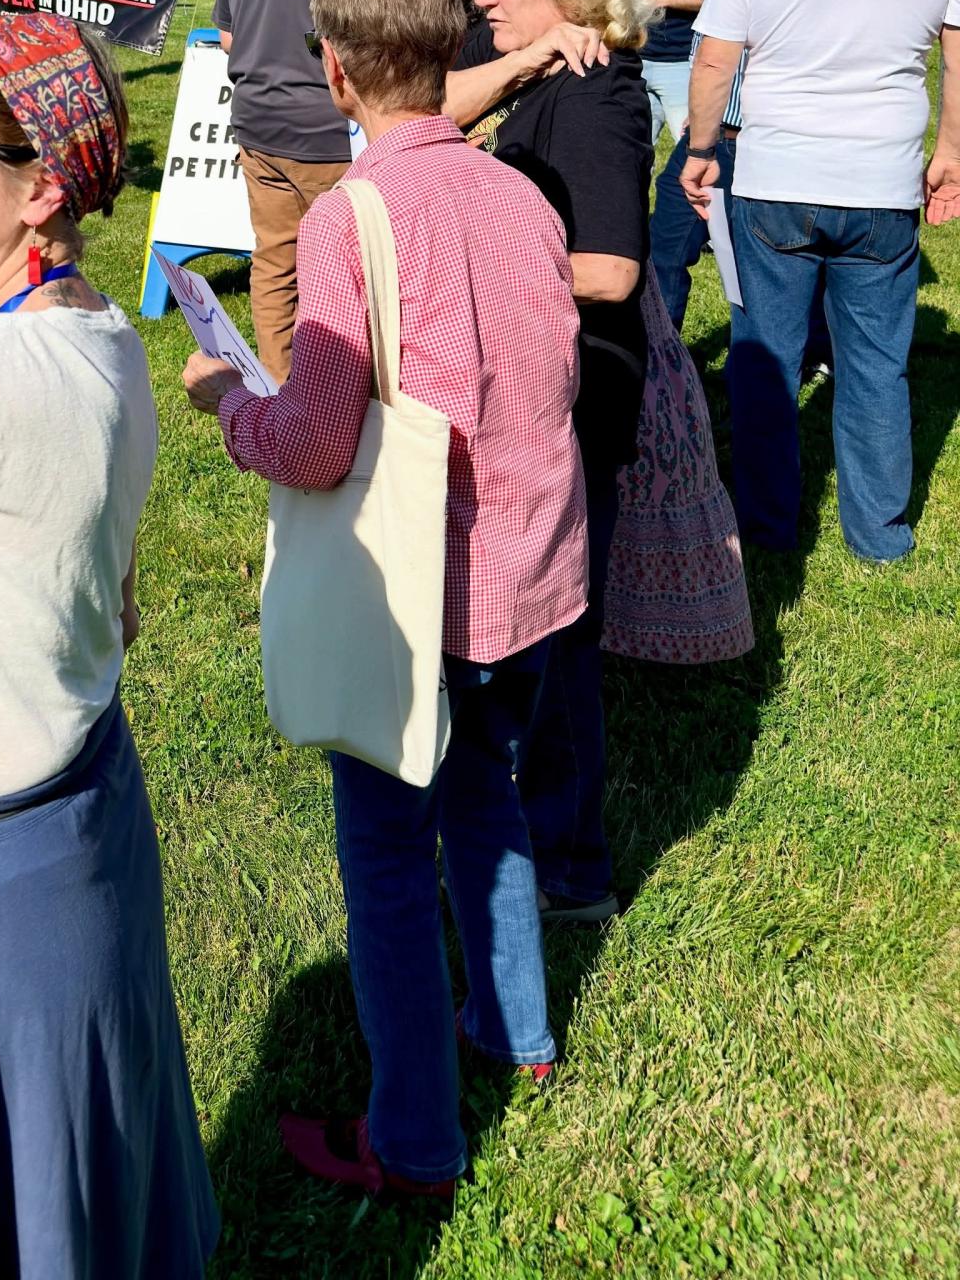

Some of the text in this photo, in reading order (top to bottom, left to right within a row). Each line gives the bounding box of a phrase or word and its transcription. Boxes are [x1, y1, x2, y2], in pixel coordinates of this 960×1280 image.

[218, 86, 233, 105] D
[169, 156, 242, 179] PETIT
[163, 256, 204, 305] NO
[205, 347, 256, 378] TA
